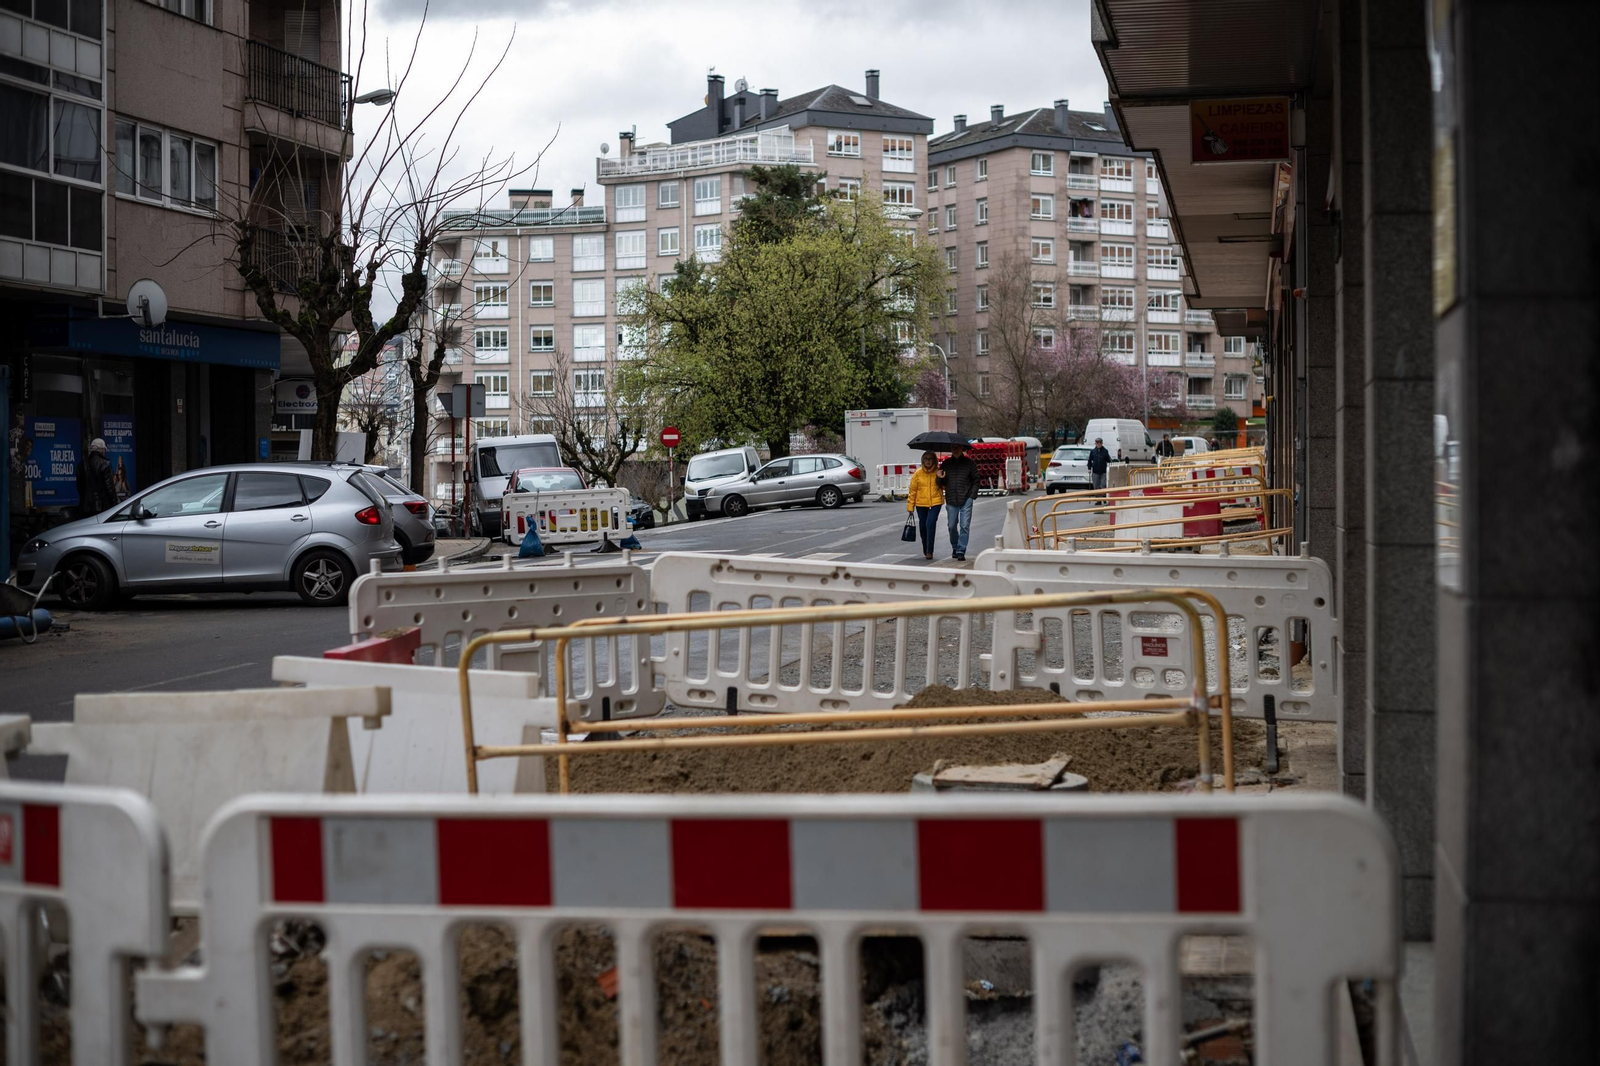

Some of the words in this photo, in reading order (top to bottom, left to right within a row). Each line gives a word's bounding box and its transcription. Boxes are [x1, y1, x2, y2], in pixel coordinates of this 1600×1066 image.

[1208, 102, 1284, 116] LIMPIEZAS
[1219, 121, 1285, 134] CANEIRO
[139, 329, 200, 348] santalucía
[50, 450, 75, 462] TARJETA
[52, 463, 74, 475] REGALO
